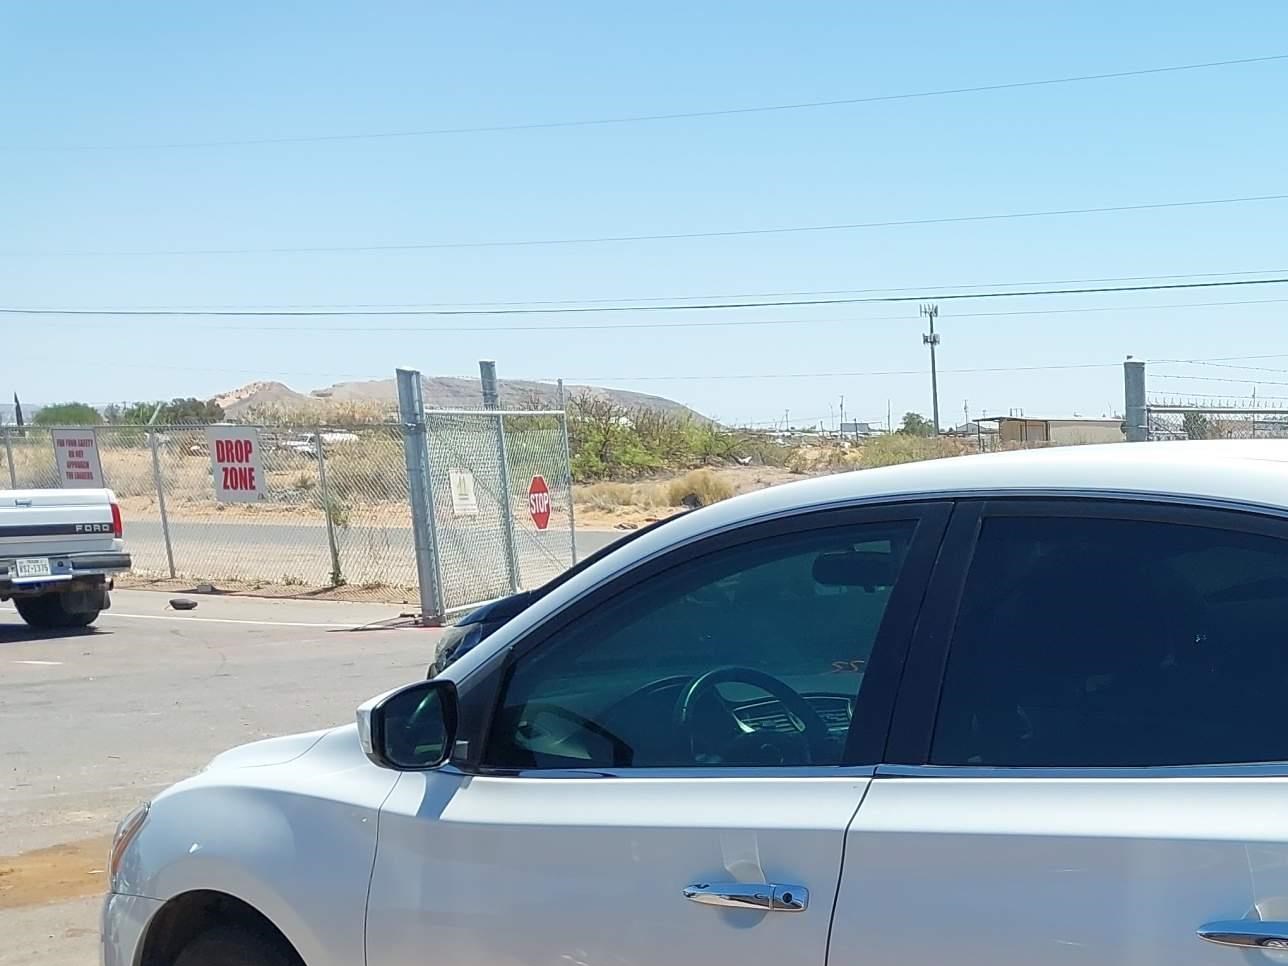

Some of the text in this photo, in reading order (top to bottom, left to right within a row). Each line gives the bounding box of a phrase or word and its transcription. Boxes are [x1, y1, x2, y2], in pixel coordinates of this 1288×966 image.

[215, 439, 253, 463] DROP
[222, 467, 256, 490] ZONE
[529, 493, 549, 515] STOP
[75, 524, 110, 533] FORD
